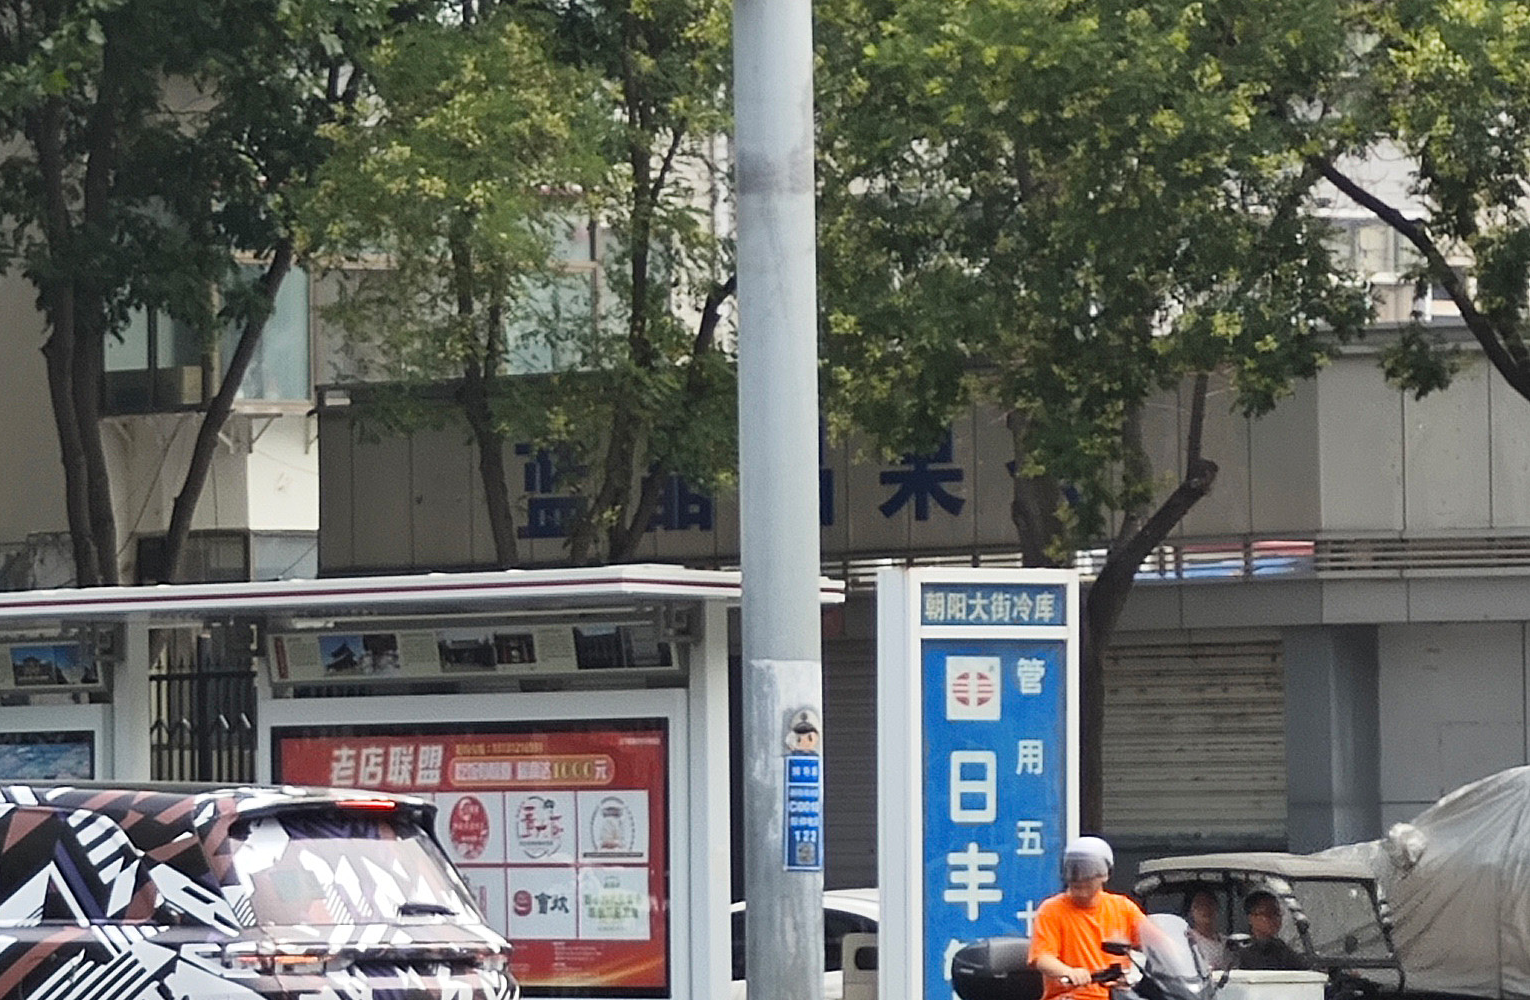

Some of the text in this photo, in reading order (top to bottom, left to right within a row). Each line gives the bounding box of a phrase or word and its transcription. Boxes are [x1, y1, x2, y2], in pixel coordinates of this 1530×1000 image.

[924, 590, 1055, 622] 朝阳大街冷库
[330, 745, 443, 786] 老店联盟
